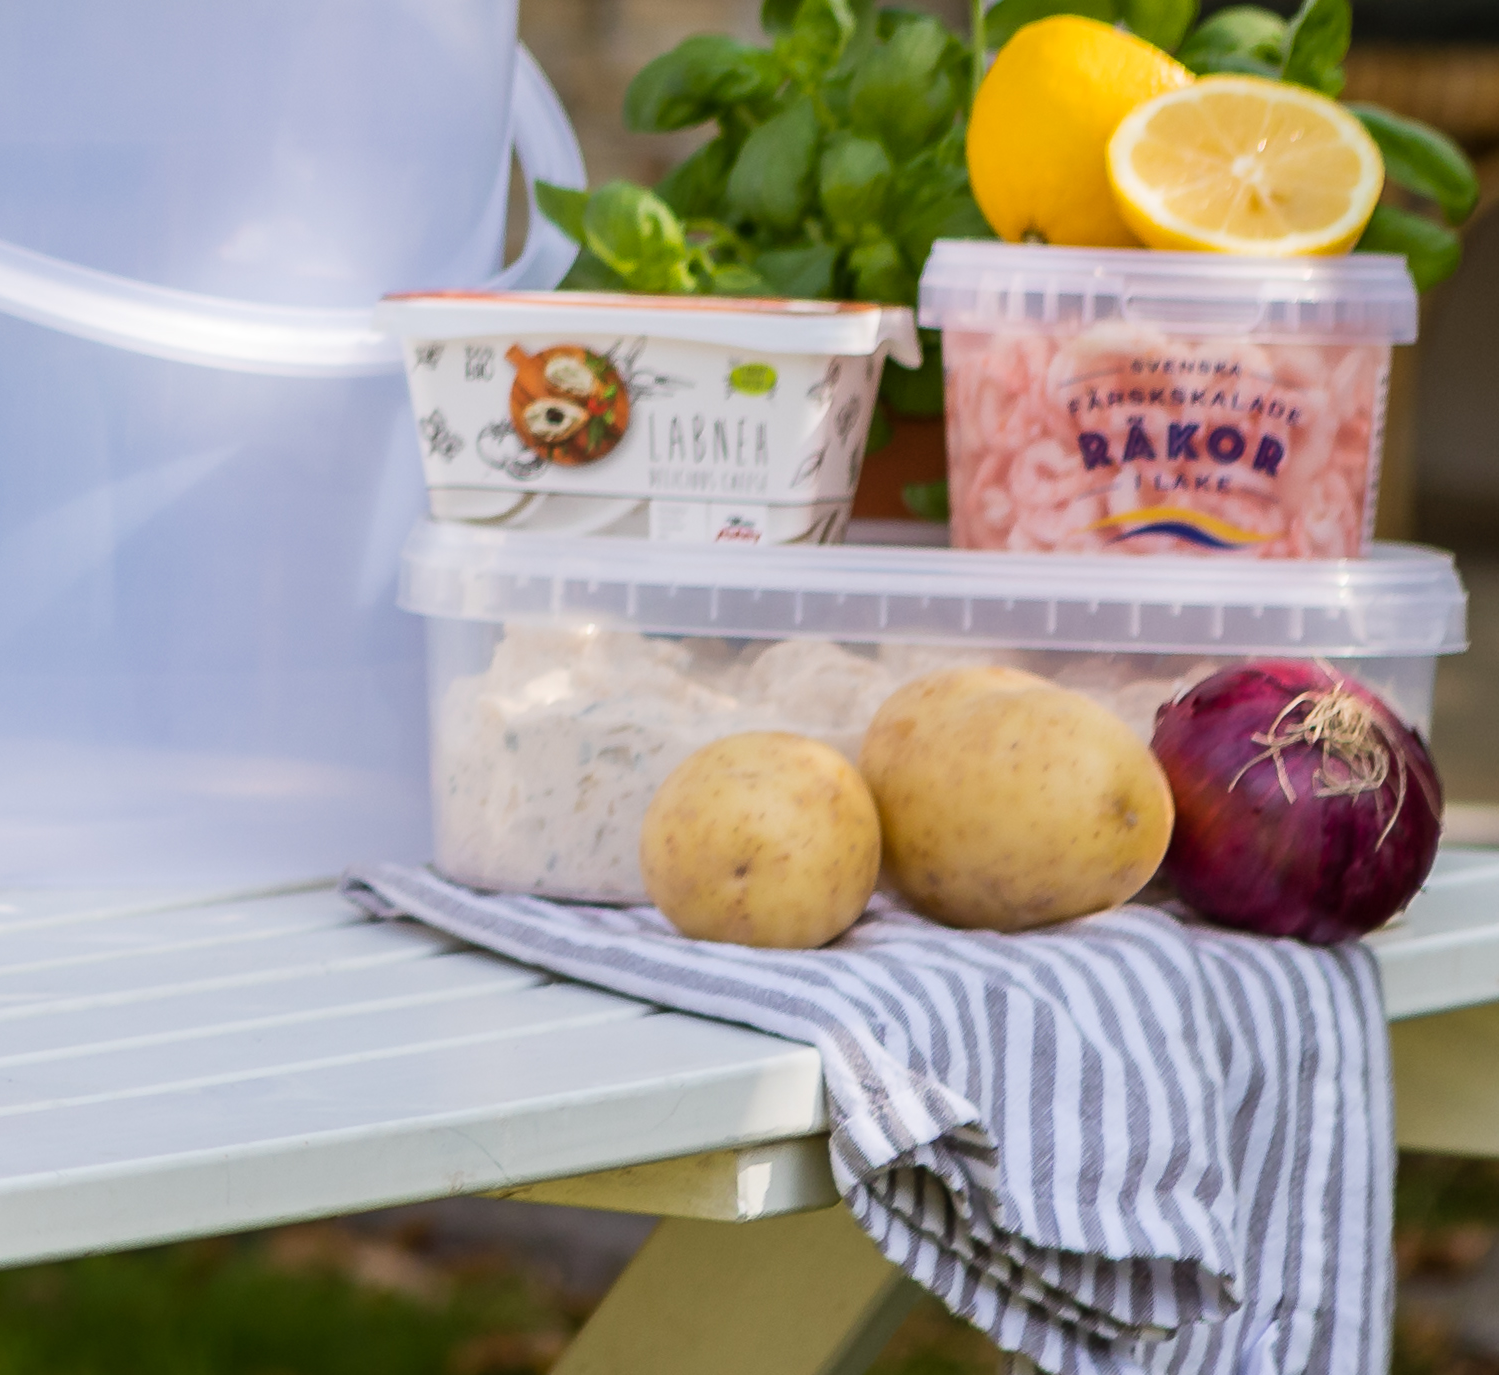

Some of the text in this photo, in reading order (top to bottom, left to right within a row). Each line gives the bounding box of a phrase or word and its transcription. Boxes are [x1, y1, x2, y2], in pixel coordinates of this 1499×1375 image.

[1130, 359, 1241, 377] SVENSKA
[1078, 415, 1284, 478] RÄKOR
[1153, 473, 1233, 493] LAKE
